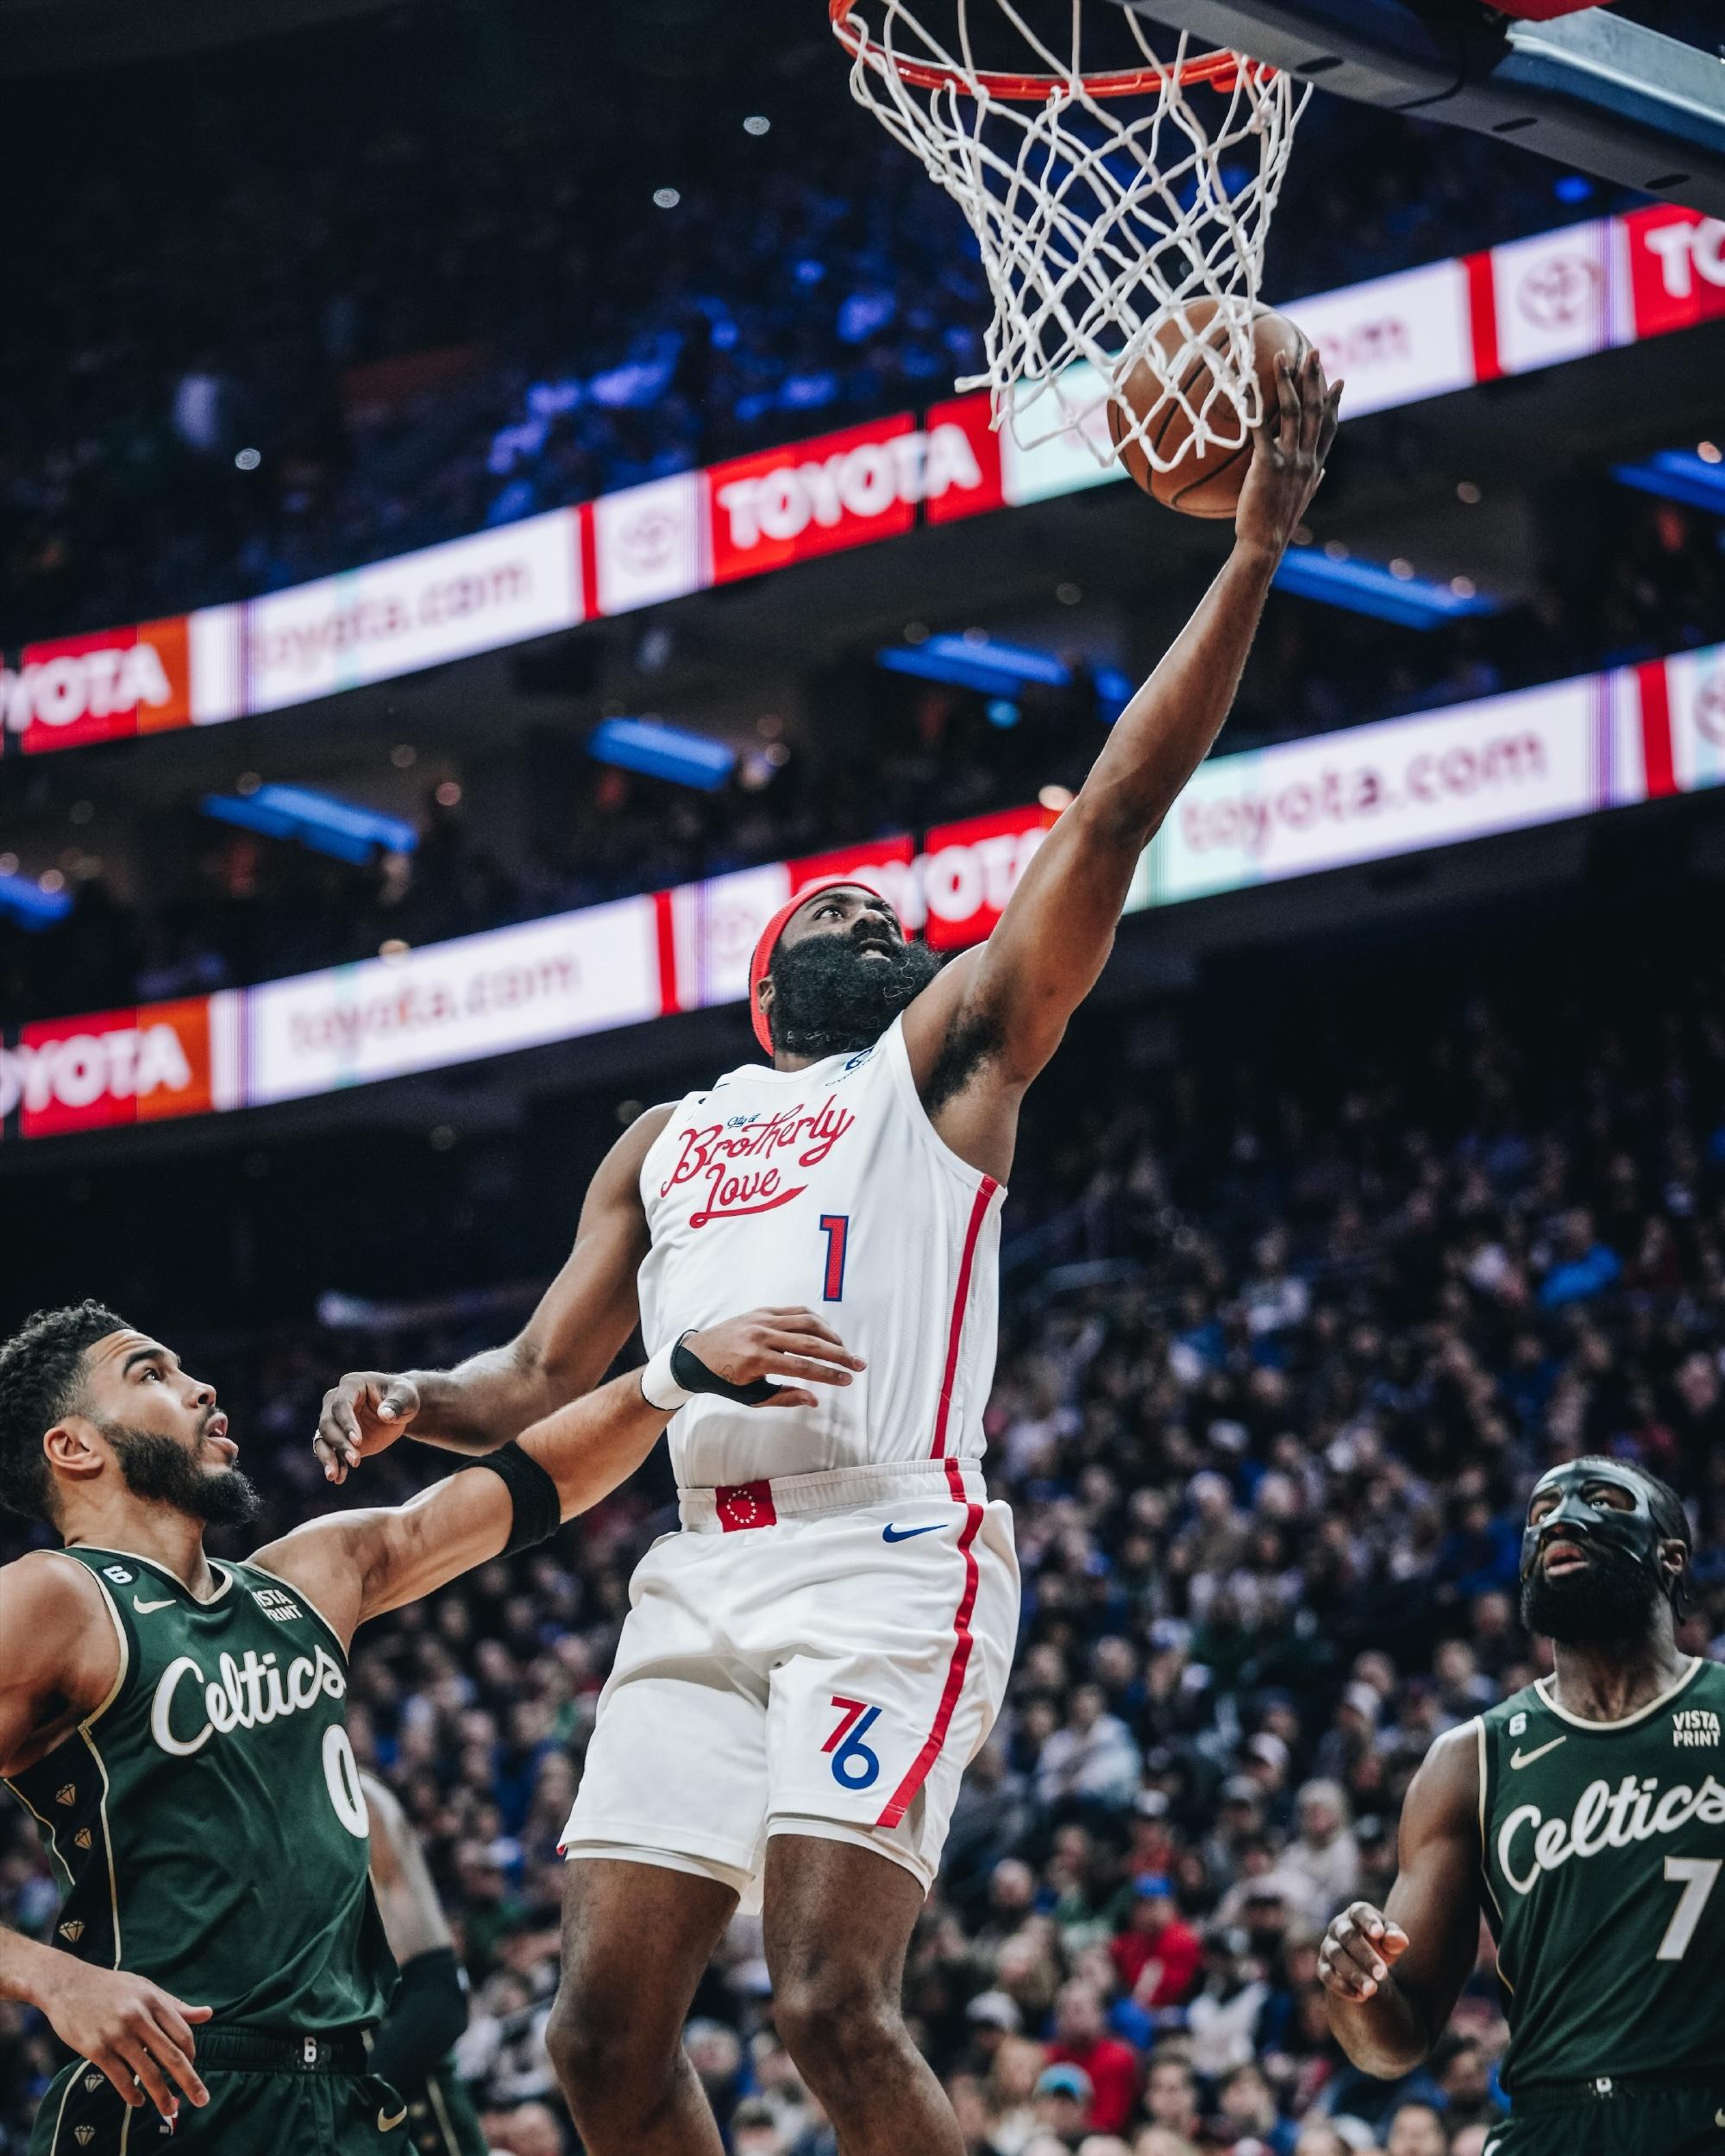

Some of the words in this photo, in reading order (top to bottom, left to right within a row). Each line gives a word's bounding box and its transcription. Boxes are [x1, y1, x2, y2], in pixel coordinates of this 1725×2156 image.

[717, 423, 982, 549] TOYOTA
[1182, 730, 1546, 856] toyota.com
[661, 1094, 856, 1197] Brotherly
[689, 1163, 808, 1229] Love
[819, 1213, 849, 1302] 1
[103, 1565, 133, 1584] 6
[151, 1644, 347, 1756] Celtics
[820, 1695, 883, 1790] 76
[1509, 1712, 1527, 1737] 6
[1672, 1709, 1721, 1734] VISTA
[1673, 1729, 1719, 1747] PRINT
[323, 1725, 370, 1839] 0
[1497, 1775, 1725, 1896] Celtics
[1656, 1856, 1723, 1961] 7
[304, 2036, 317, 2062] 6
